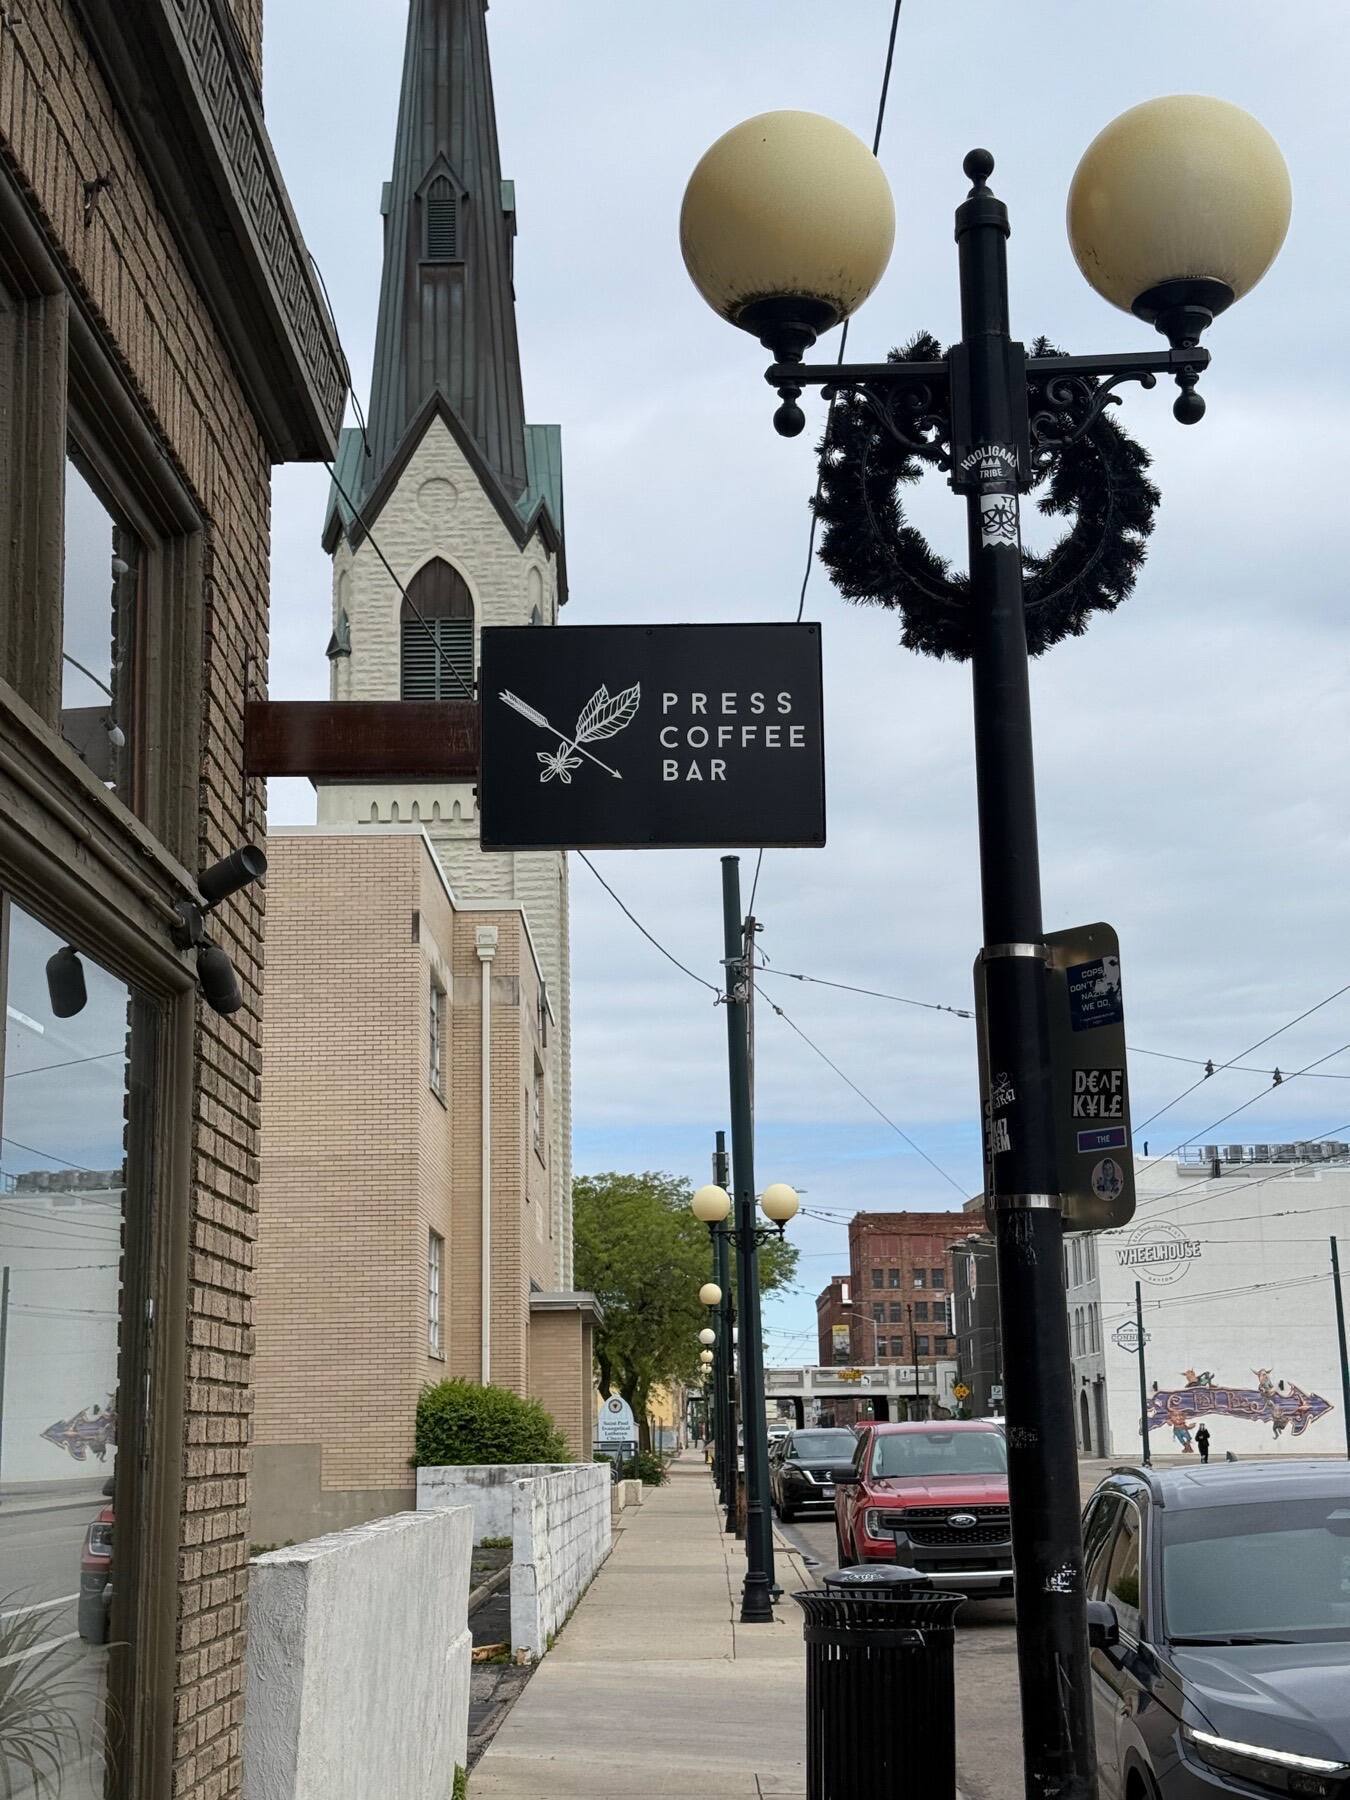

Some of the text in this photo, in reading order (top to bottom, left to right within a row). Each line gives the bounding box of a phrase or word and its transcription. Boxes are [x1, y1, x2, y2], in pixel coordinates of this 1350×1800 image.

[960, 445, 1017, 471] HOOLIGANS
[980, 468, 1002, 478] TRIBE
[662, 692, 792, 715] PRESS
[659, 726, 806, 748] COFFEE
[662, 759, 727, 781] BAR
[1081, 966, 1104, 979] COPS
[1081, 1002, 1095, 1012] WE
[1096, 1134, 1111, 1144] THE
[1115, 1241, 1202, 1266] WHEELHOUSE
[1111, 1333, 1152, 1343] CONNT
